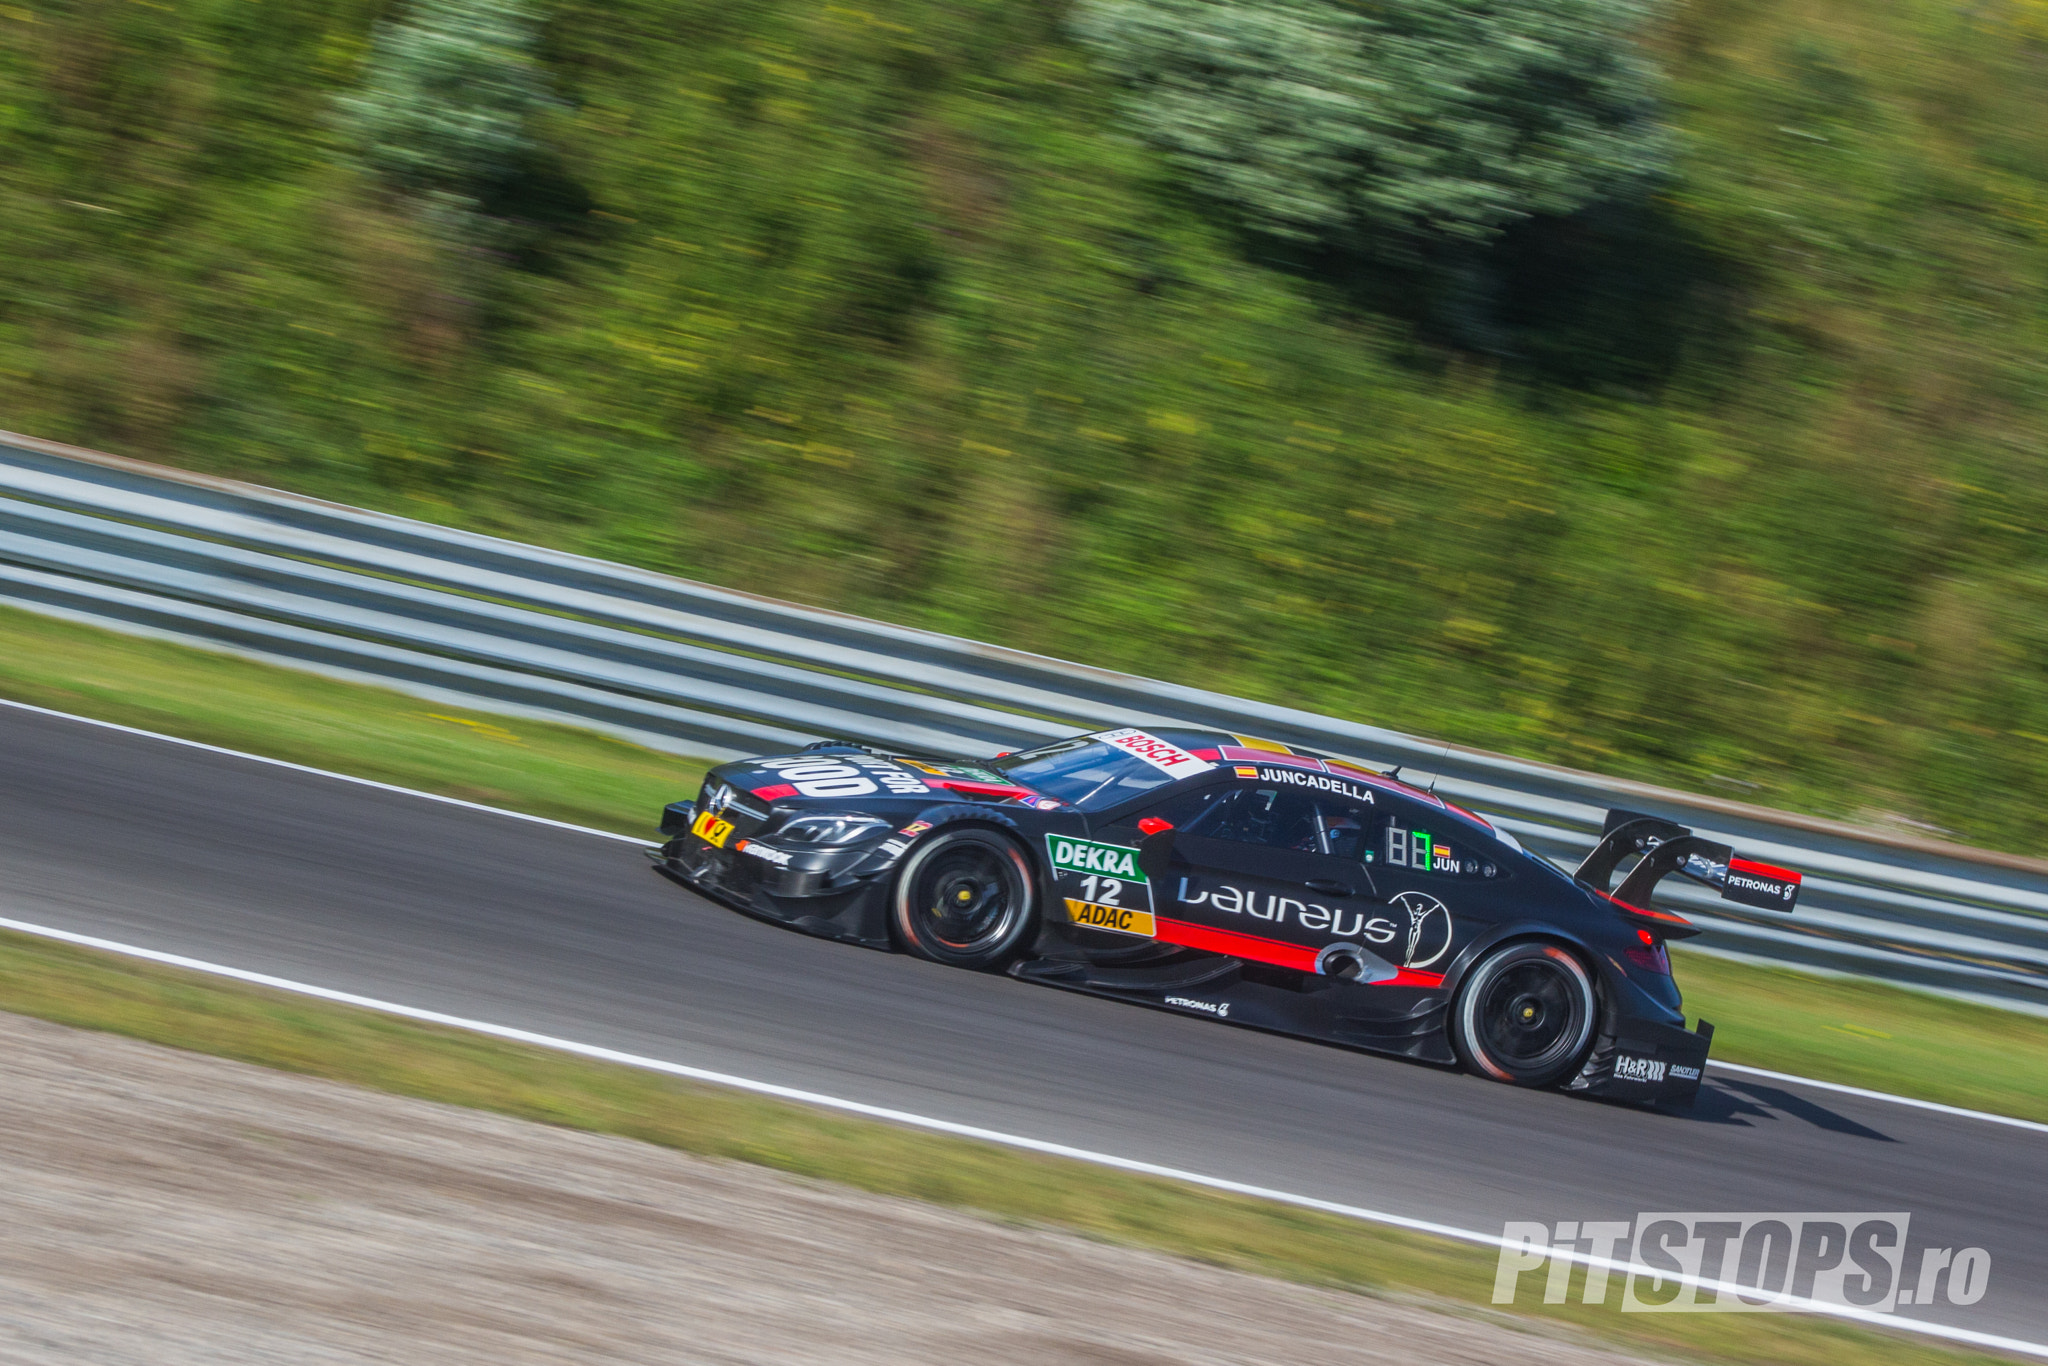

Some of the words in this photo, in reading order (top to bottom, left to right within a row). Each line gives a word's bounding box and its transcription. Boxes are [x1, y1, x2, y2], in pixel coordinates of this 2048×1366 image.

[1115, 734, 1191, 767] BOSCH
[871, 771, 931, 794] FOR
[1260, 768, 1375, 805] JUNCADELLA
[1055, 841, 1136, 877] DEKRA
[1433, 858, 1460, 874] JUN
[1080, 875, 1122, 906] 12
[1728, 875, 1781, 895] PETRONAS
[1078, 904, 1133, 930] ADAC
[1164, 996, 1217, 1012] PETRONAS
[1615, 1054, 1648, 1077] H&R
